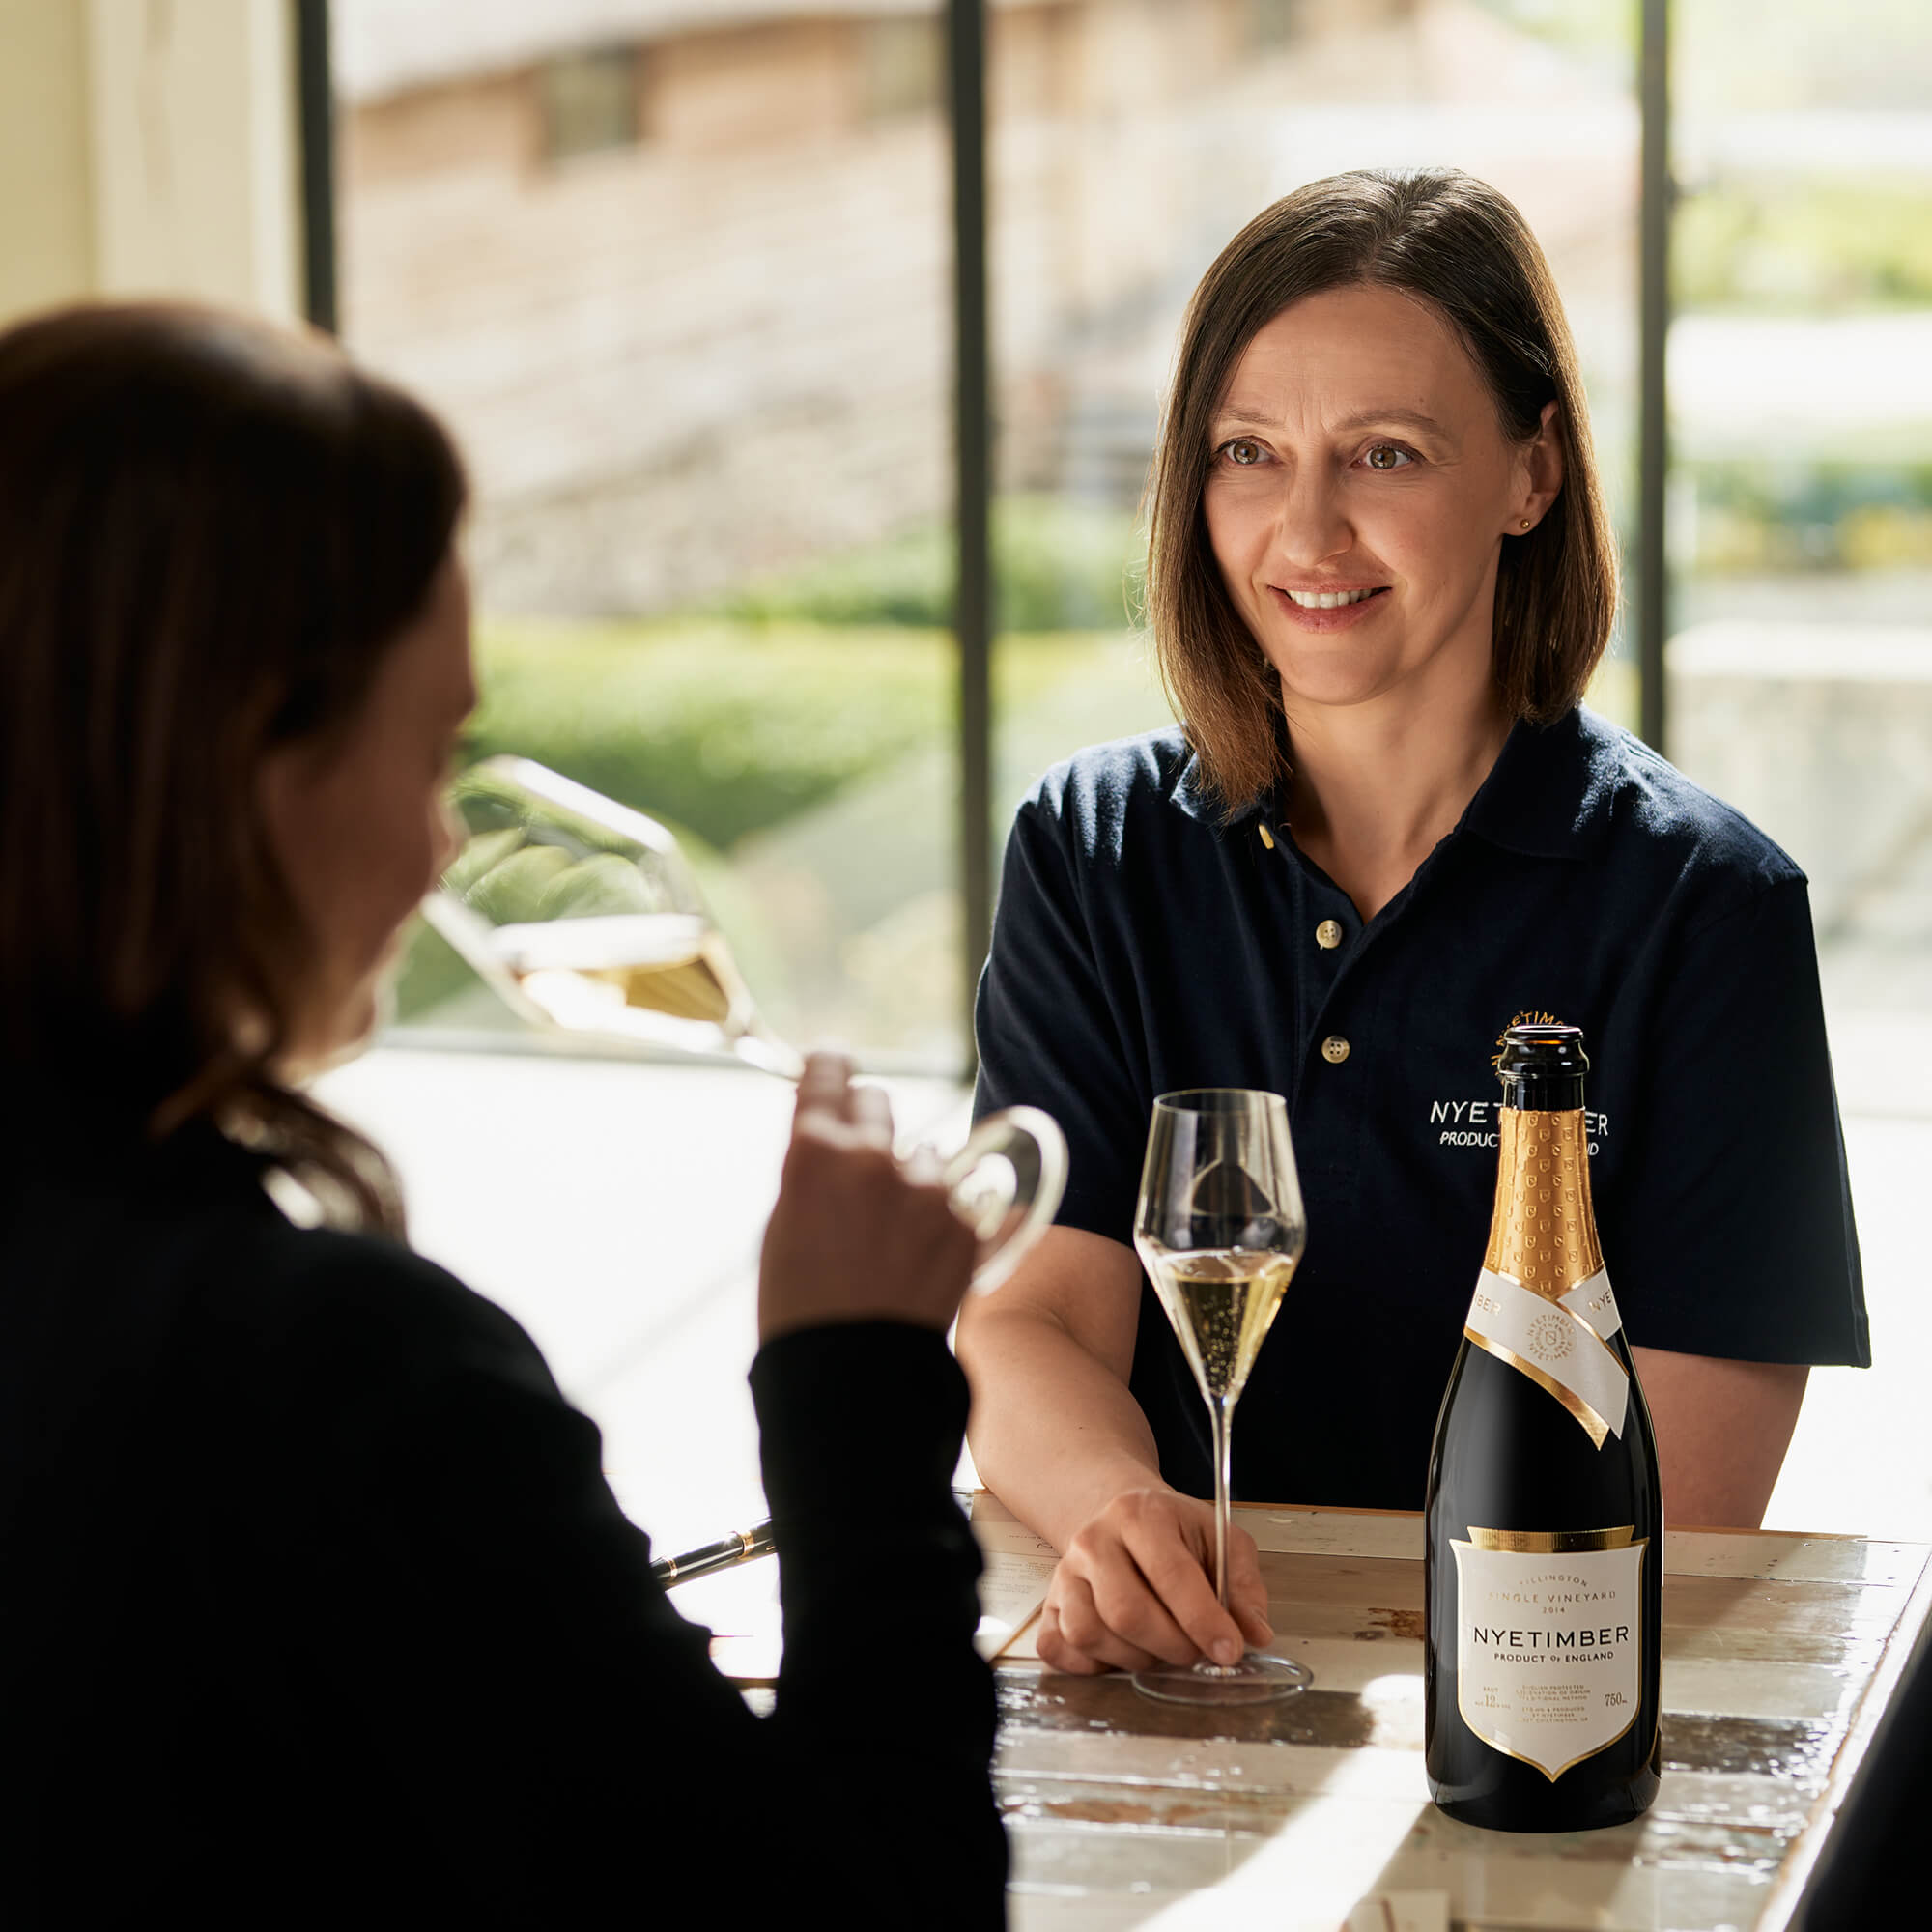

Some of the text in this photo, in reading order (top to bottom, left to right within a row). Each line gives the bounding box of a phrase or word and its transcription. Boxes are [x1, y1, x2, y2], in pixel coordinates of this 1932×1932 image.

[1439, 1131, 1500, 1148] PRODUC
[1518, 1574, 1587, 1587] ILLINGTON
[1548, 1590, 1616, 1603] VINEYARD
[1474, 1625, 1629, 1648] NYETIMBER
[1494, 1652, 1545, 1662] PRODUCT
[1565, 1651, 1614, 1662] ENGLAND
